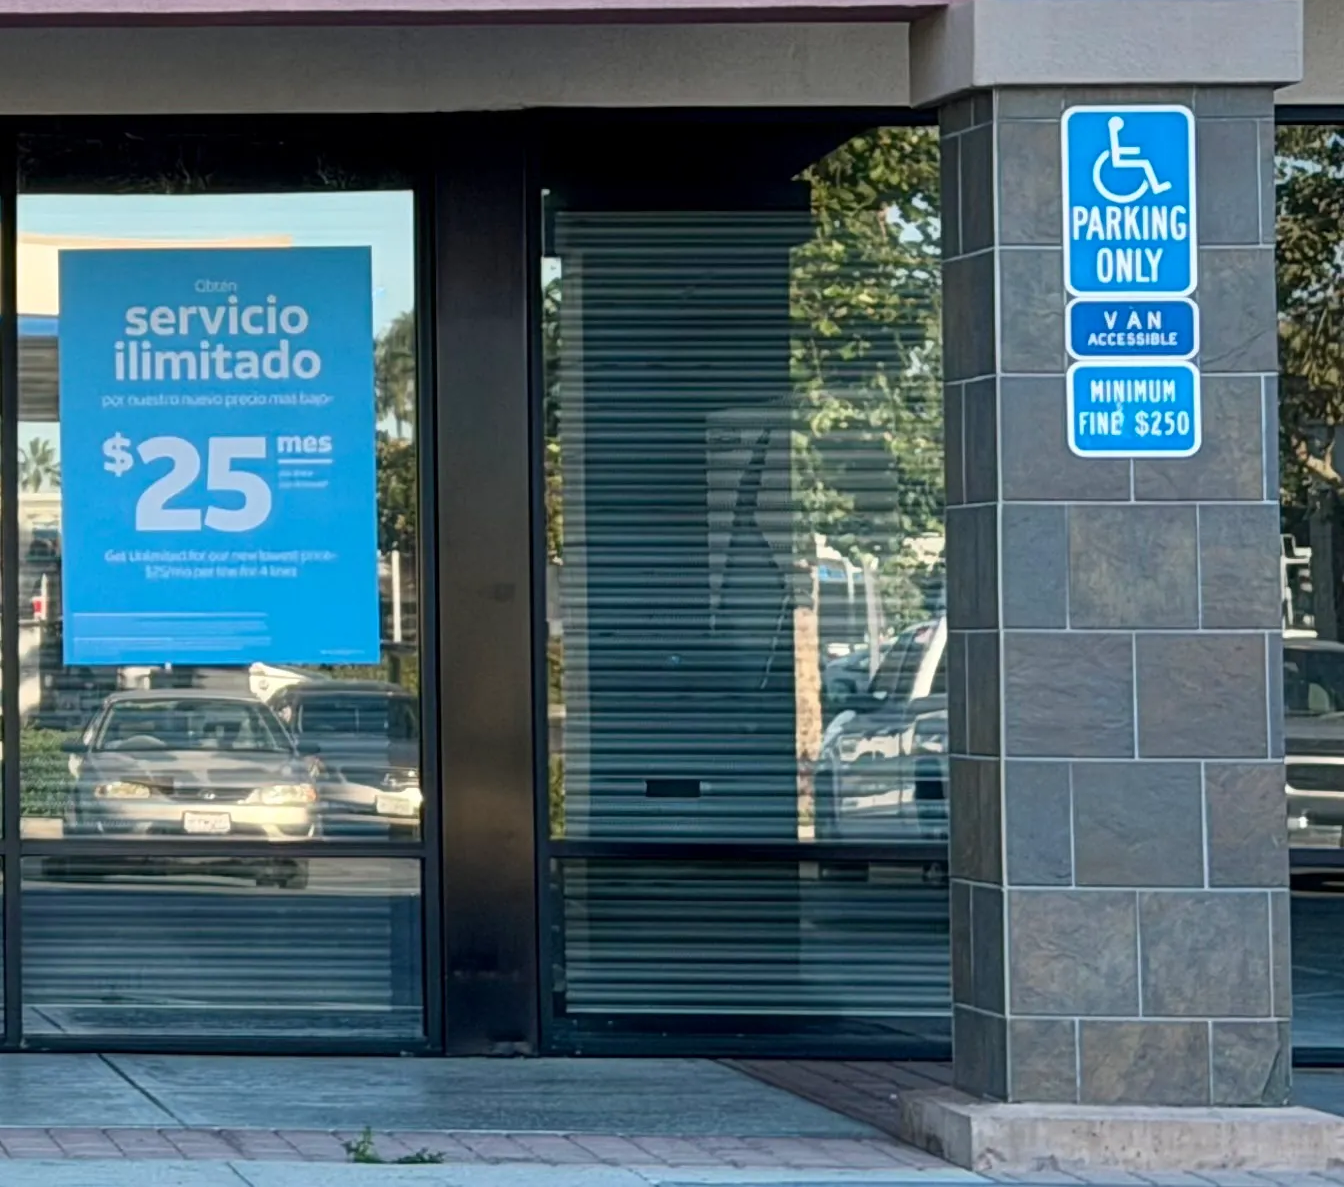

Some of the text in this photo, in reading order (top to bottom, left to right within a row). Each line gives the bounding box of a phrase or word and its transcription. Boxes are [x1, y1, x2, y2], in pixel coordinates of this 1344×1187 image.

[1072, 205, 1188, 241] PARKING
[1096, 247, 1164, 284] ONLY
[125, 295, 309, 335] servicio
[1103, 311, 1162, 330] VAN
[1087, 332, 1178, 346] ACCESSIBLE
[114, 339, 322, 381] ilimitado
[1090, 379, 1176, 403] MINIMUM
[1078, 410, 1190, 437] FINE $250
[102, 432, 333, 532] $25 mes
